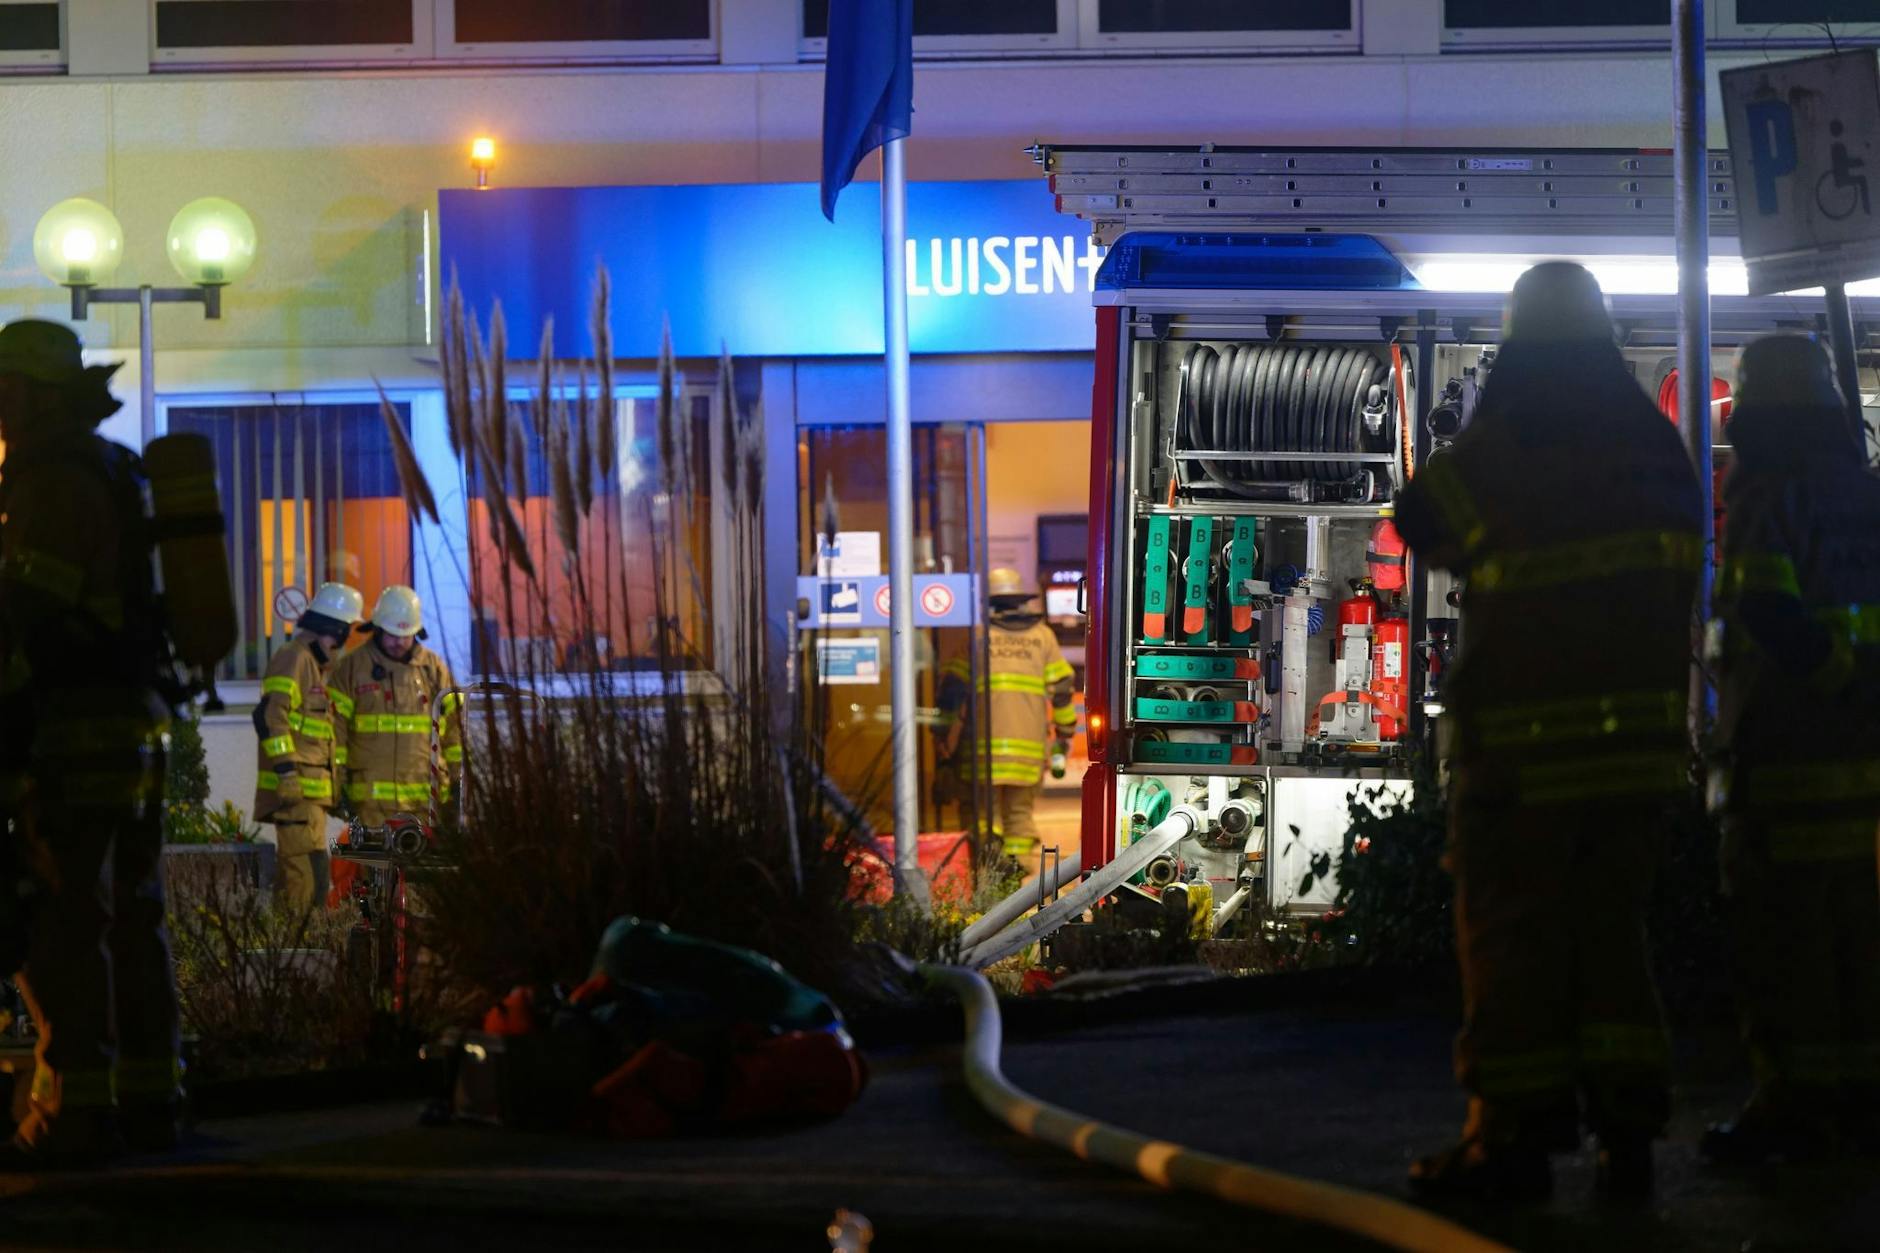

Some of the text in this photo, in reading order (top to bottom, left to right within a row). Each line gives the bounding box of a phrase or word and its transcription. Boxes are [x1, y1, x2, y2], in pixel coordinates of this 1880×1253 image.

[1746, 100, 1797, 215] P
[1153, 532, 1163, 547] B
[1196, 529, 1206, 543] B
[1239, 526, 1249, 540] B
[1150, 590, 1161, 606] B
[1191, 584, 1202, 599] B
[1155, 705, 1169, 715] B
